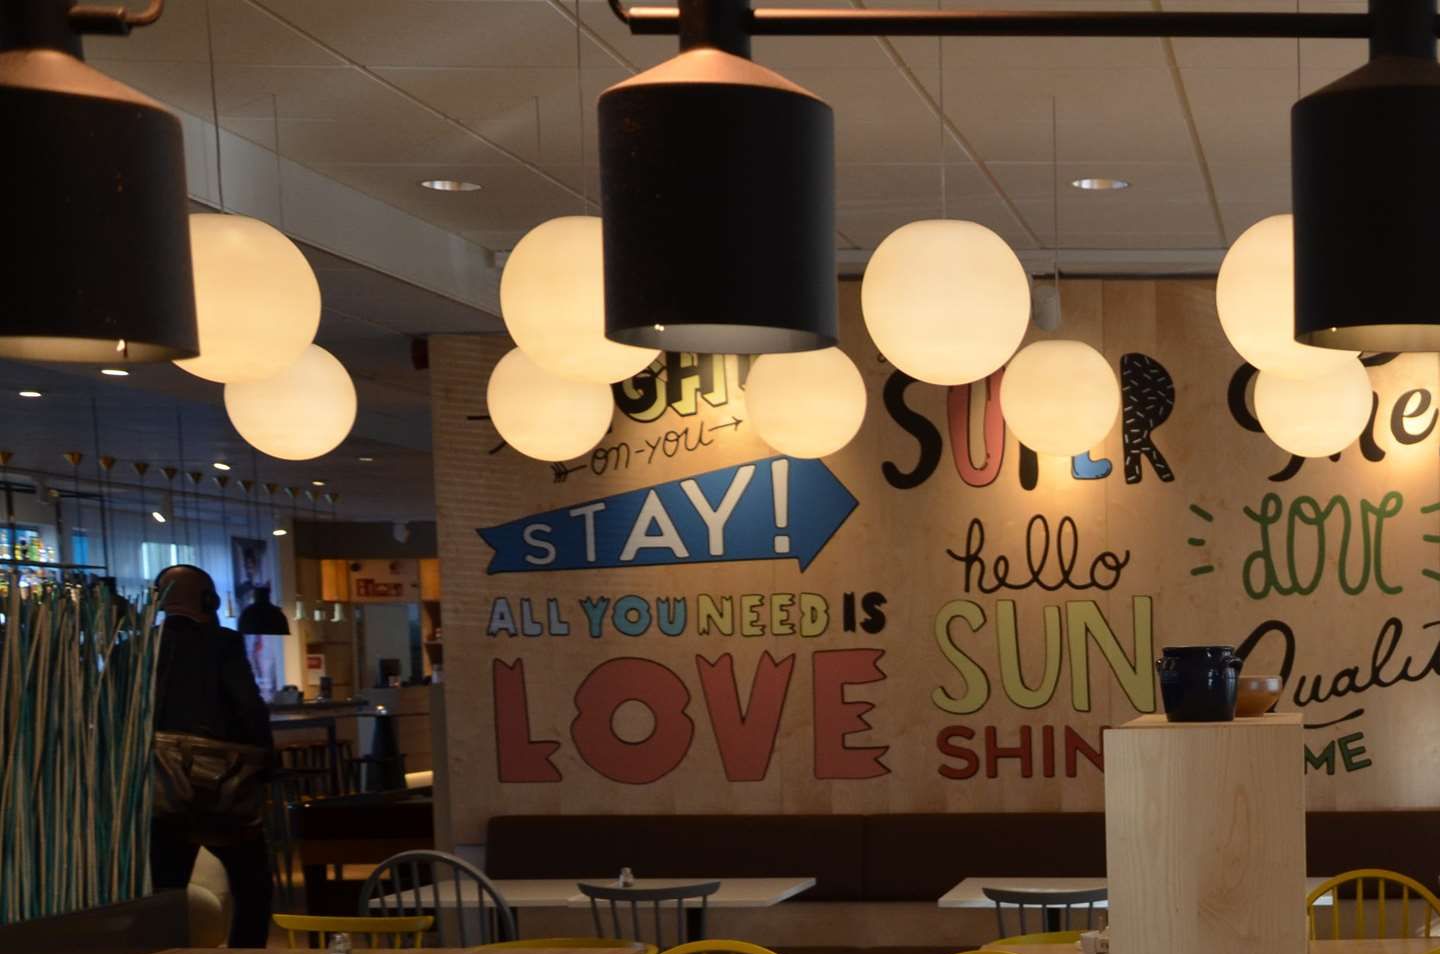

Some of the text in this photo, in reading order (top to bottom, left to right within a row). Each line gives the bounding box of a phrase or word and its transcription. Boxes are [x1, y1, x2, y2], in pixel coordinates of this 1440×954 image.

[882, 352, 1175, 491] SUR
[523, 457, 791, 566] STAY!
[946, 514, 1130, 594] hello
[486, 591, 888, 638] ALL YOU NEED IS
[931, 595, 1157, 715] SUN
[492, 647, 892, 785] LOVE
